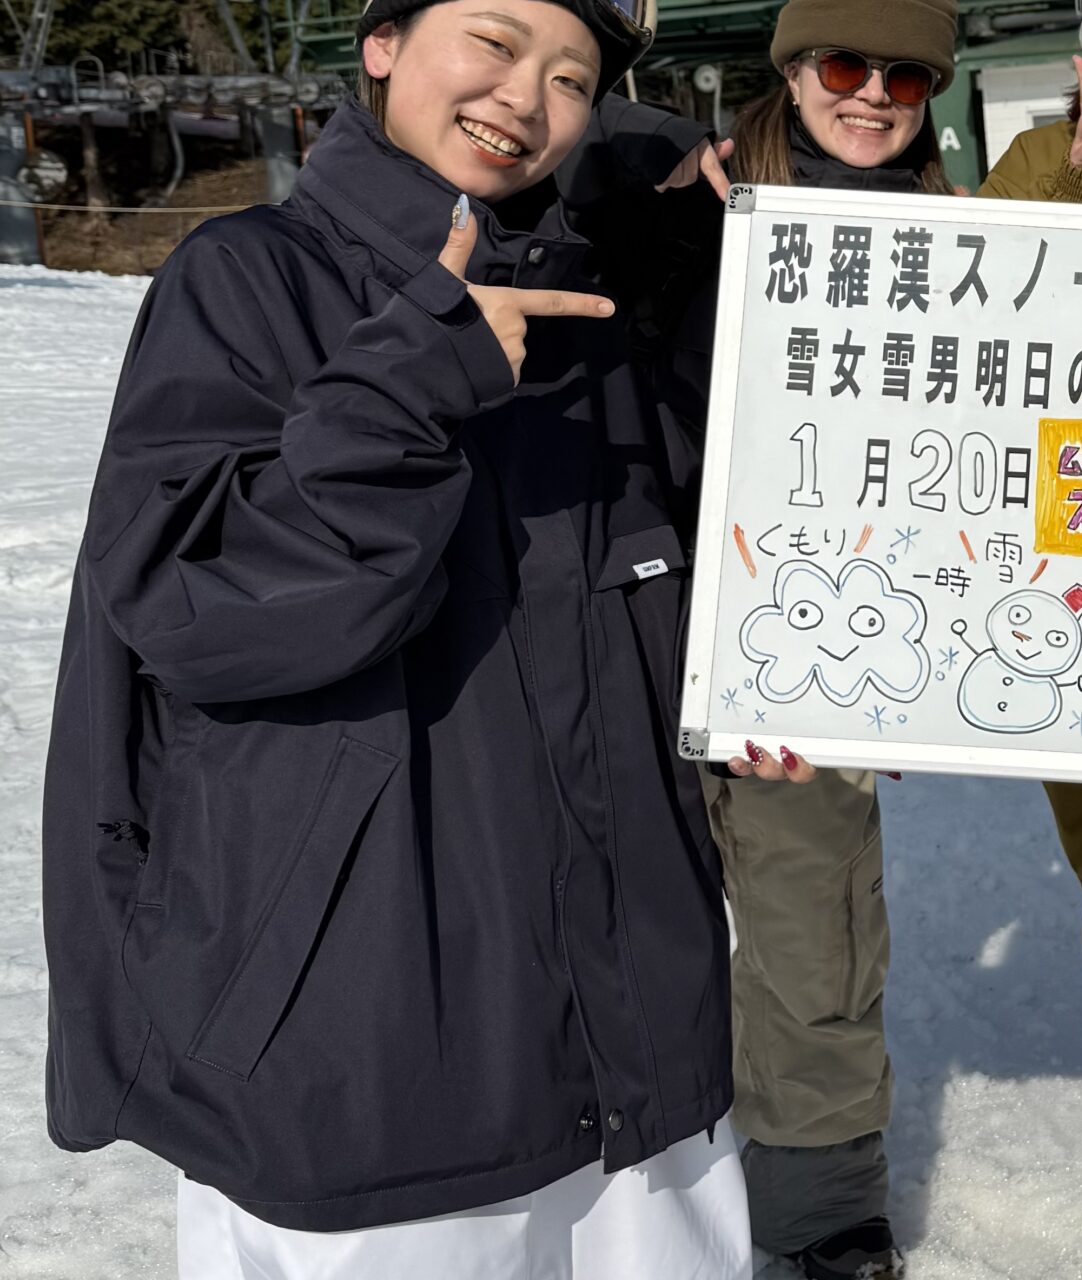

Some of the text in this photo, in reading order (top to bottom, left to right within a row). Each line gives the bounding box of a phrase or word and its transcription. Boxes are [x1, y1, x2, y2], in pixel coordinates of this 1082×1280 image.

[939, 126, 962, 151] A
[788, 422, 1033, 516] 1月20日
[756, 523, 846, 557] くもり
[985, 531, 1024, 584] 雪
[912, 565, 973, 598] 一時
